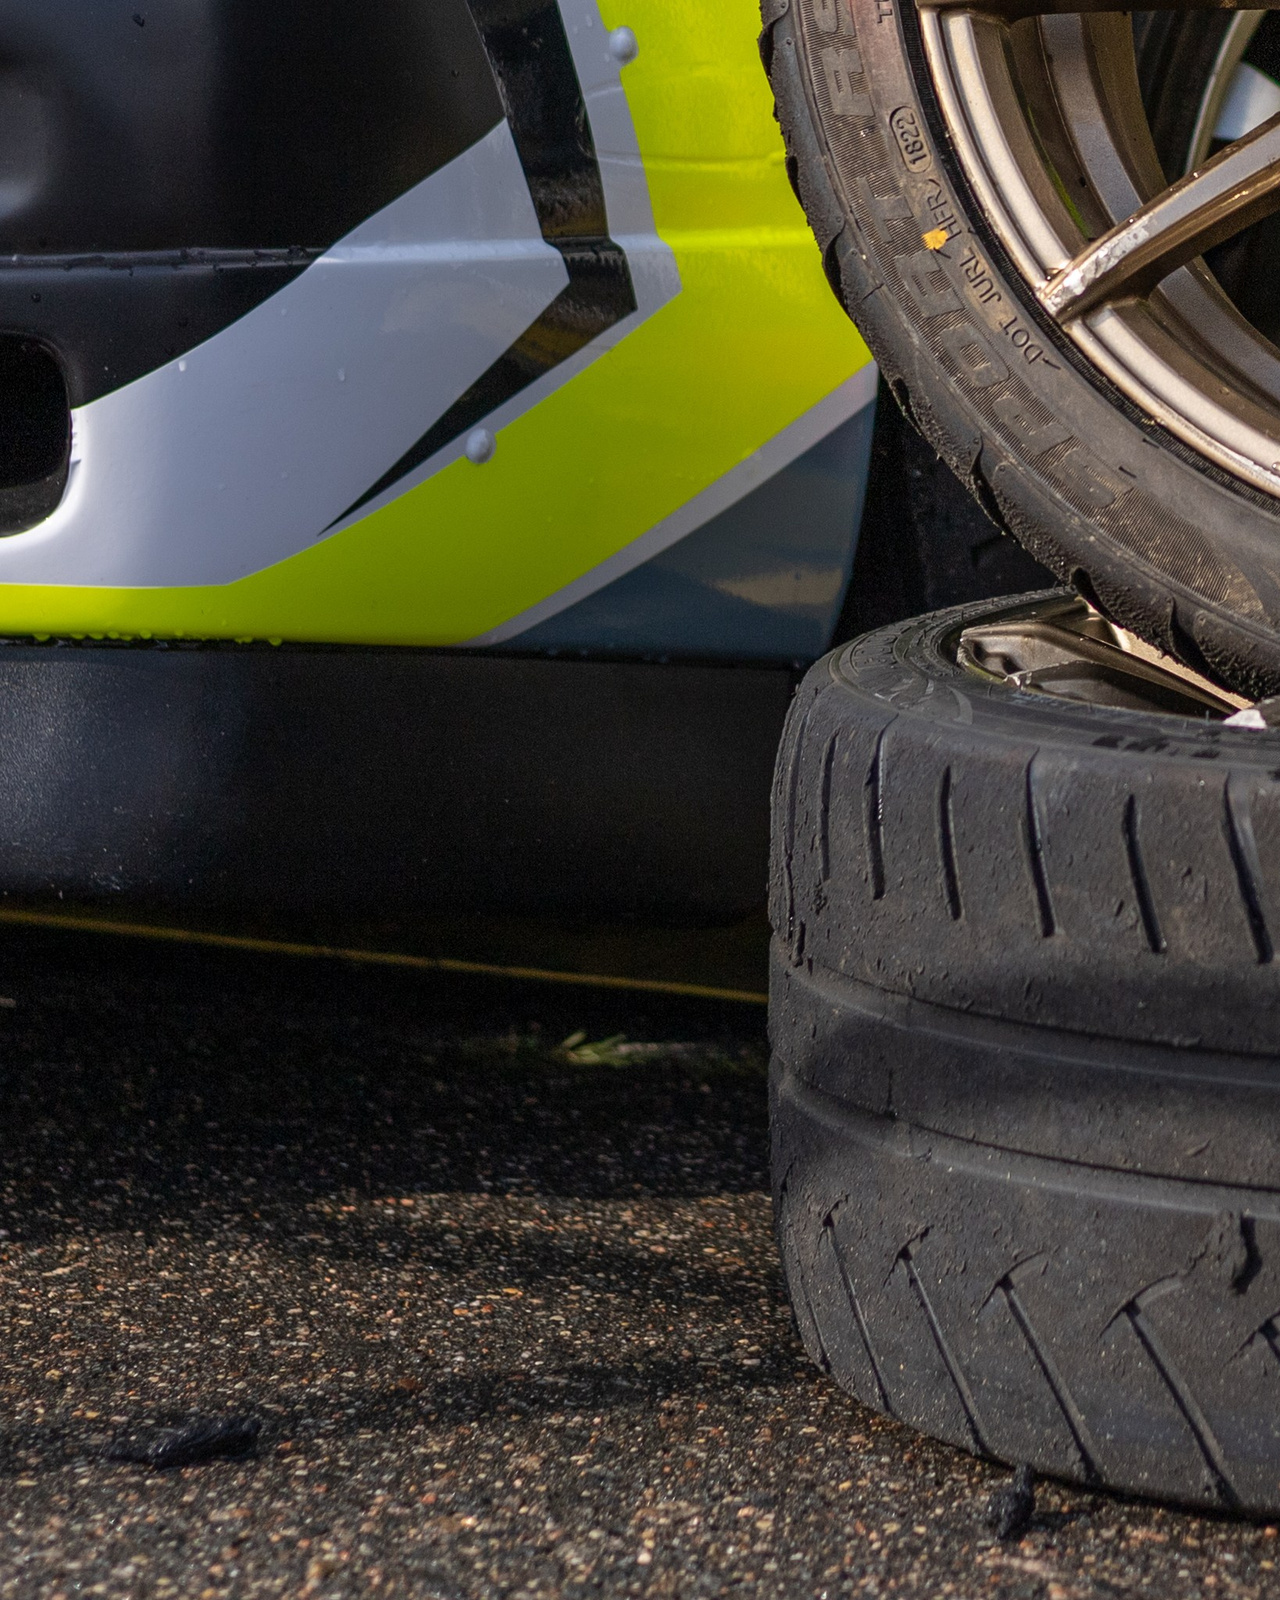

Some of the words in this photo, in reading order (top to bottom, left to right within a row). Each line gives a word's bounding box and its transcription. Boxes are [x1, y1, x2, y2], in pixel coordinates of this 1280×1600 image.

[892, 110, 930, 167] 1822
[951, 245, 1005, 311] JURL
[848, 162, 1135, 520] SPORT
[995, 311, 1046, 366] DOT
